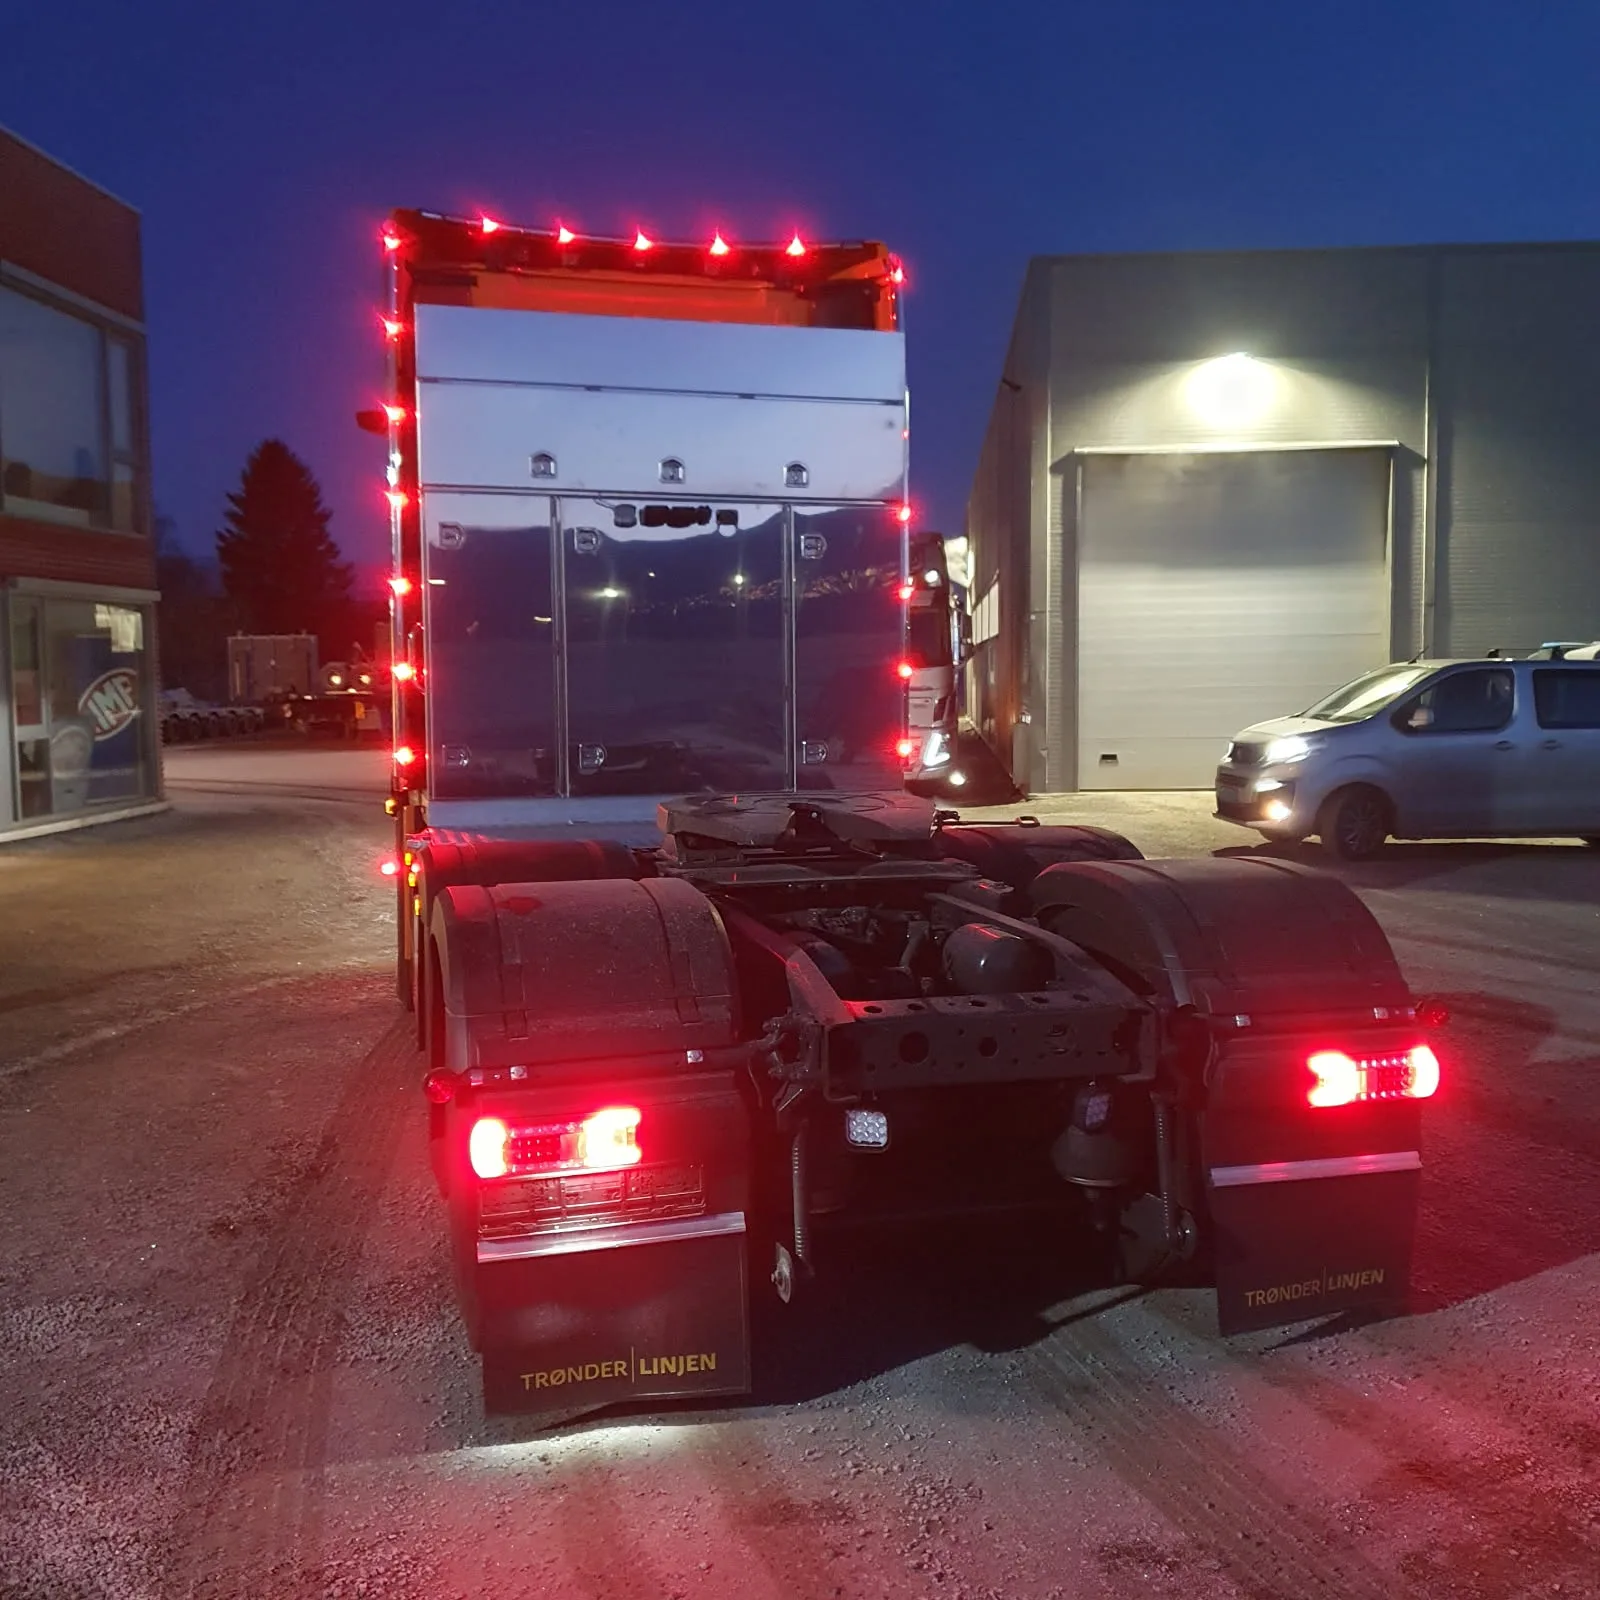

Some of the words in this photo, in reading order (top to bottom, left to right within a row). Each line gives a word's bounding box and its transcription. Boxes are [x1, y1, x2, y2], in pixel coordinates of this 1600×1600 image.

[1244, 1280, 1321, 1307] TRØNDER
[1328, 1269, 1384, 1291] LINJEN
[520, 1360, 628, 1390] TRØNDER
[639, 1353, 717, 1376] LINJEN
